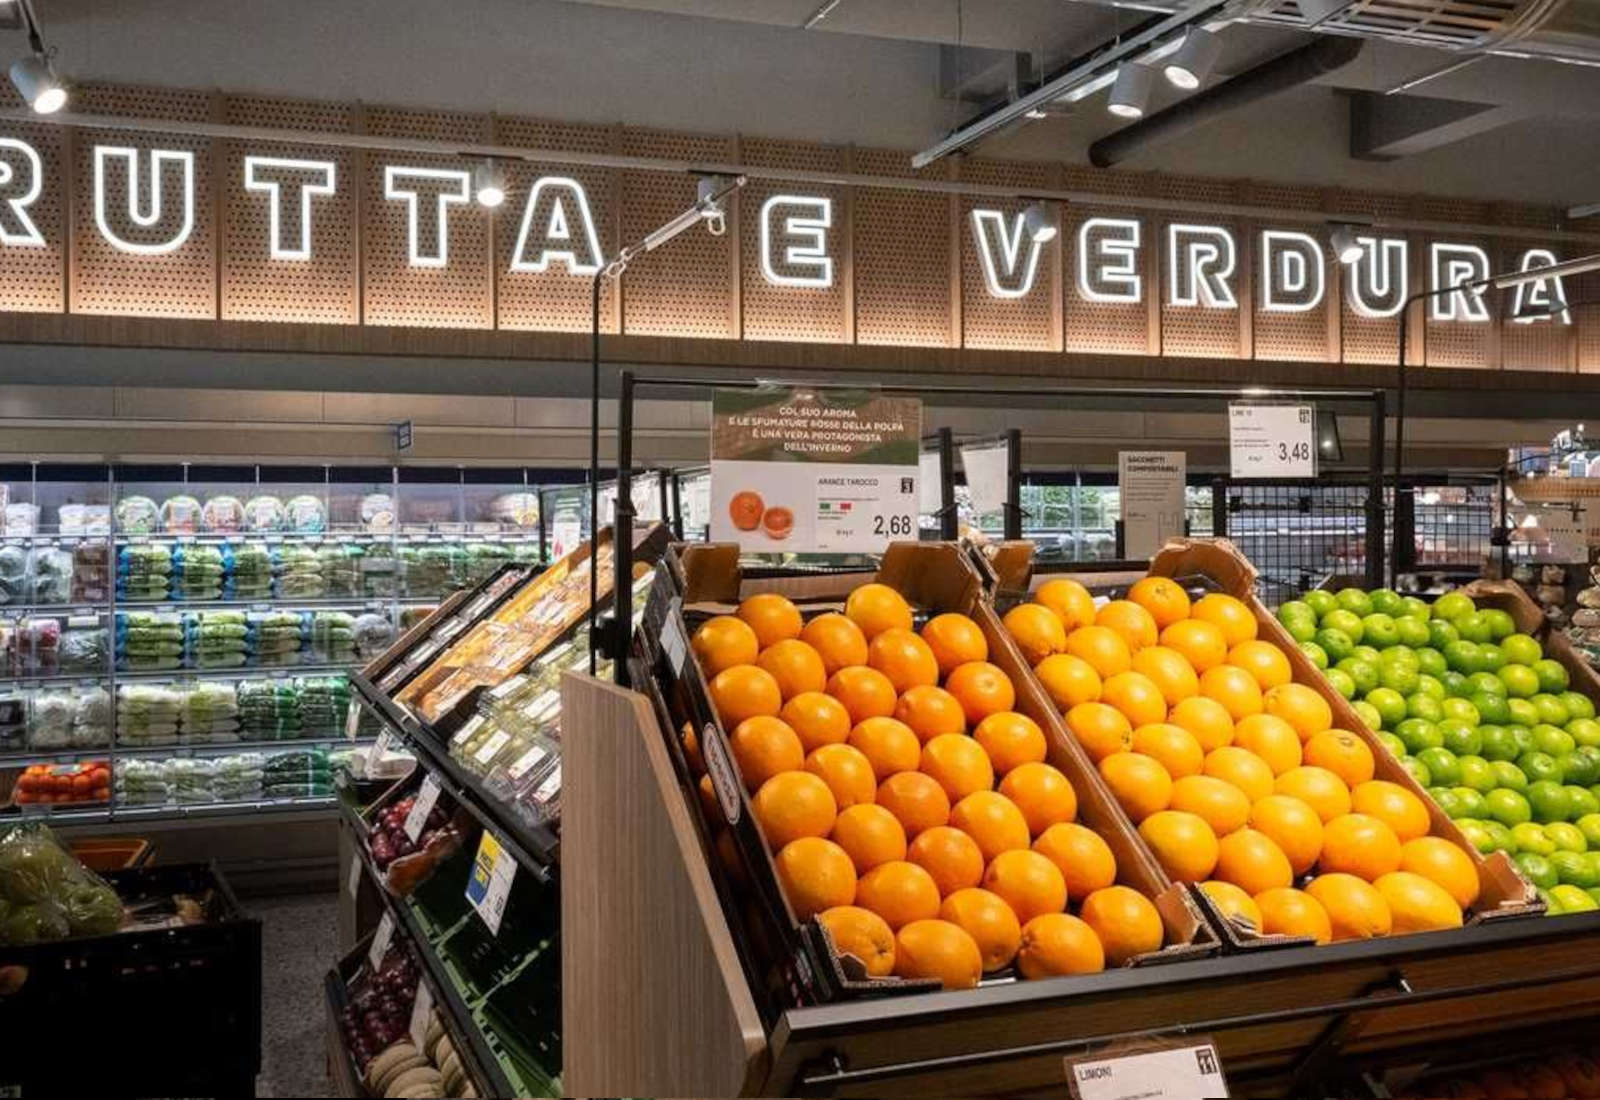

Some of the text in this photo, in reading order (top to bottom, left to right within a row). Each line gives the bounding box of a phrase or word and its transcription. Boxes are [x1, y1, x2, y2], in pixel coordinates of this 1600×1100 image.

[760, 195, 834, 288] E
[971, 208, 1571, 326] VERDURA
[779, 407, 857, 418] COL SUO AROMA
[737, 417, 749, 426] LE
[751, 417, 808, 427] SFUMATURE
[810, 419, 841, 429] ROSSE
[842, 420, 873, 430] DELLA
[874, 422, 904, 431] POLPA
[761, 430, 781, 438] UNA
[784, 431, 810, 440] VERA
[811, 432, 882, 442] PROTAGONISTA
[784, 442, 852, 453] DELL'INVERNO
[1279, 442, 1310, 464] 3,48
[818, 478, 879, 487] ARANCE TAROCCO
[873, 515, 911, 539] 2,68
[1079, 1066, 1113, 1081] LIMONI
